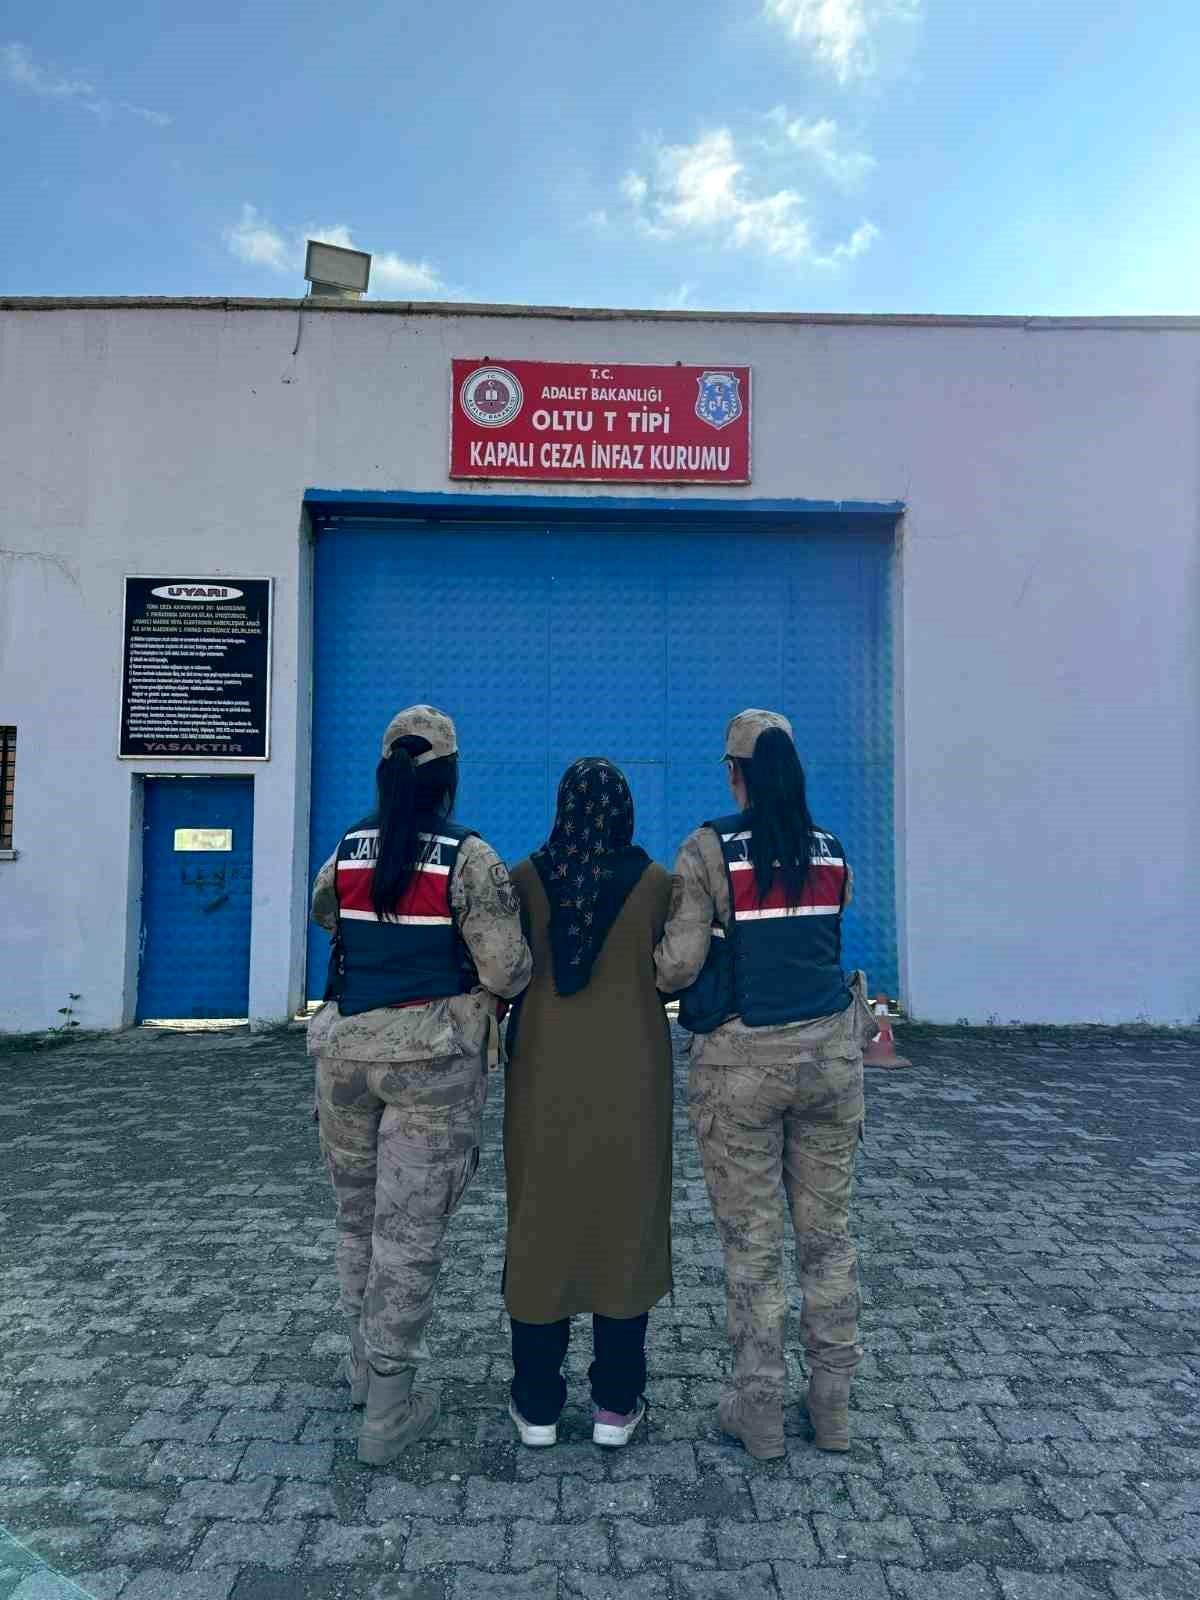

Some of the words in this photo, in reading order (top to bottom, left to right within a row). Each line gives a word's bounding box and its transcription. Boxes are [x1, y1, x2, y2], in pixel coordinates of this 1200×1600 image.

[590, 369, 614, 380] T.C.
[541, 387, 588, 400] ADALET
[591, 387, 662, 402] BAKANLIĞI
[532, 410, 593, 431] OLTU
[604, 413, 616, 432] T
[628, 405, 671, 434] TİPİ
[470, 441, 535, 467] KAPALI
[540, 443, 586, 468] CEZA
[591, 440, 645, 470] İNFAZ
[650, 446, 730, 471] KURUMU
[167, 587, 228, 597] UYARI
[143, 742, 243, 753] YASAKTIR
